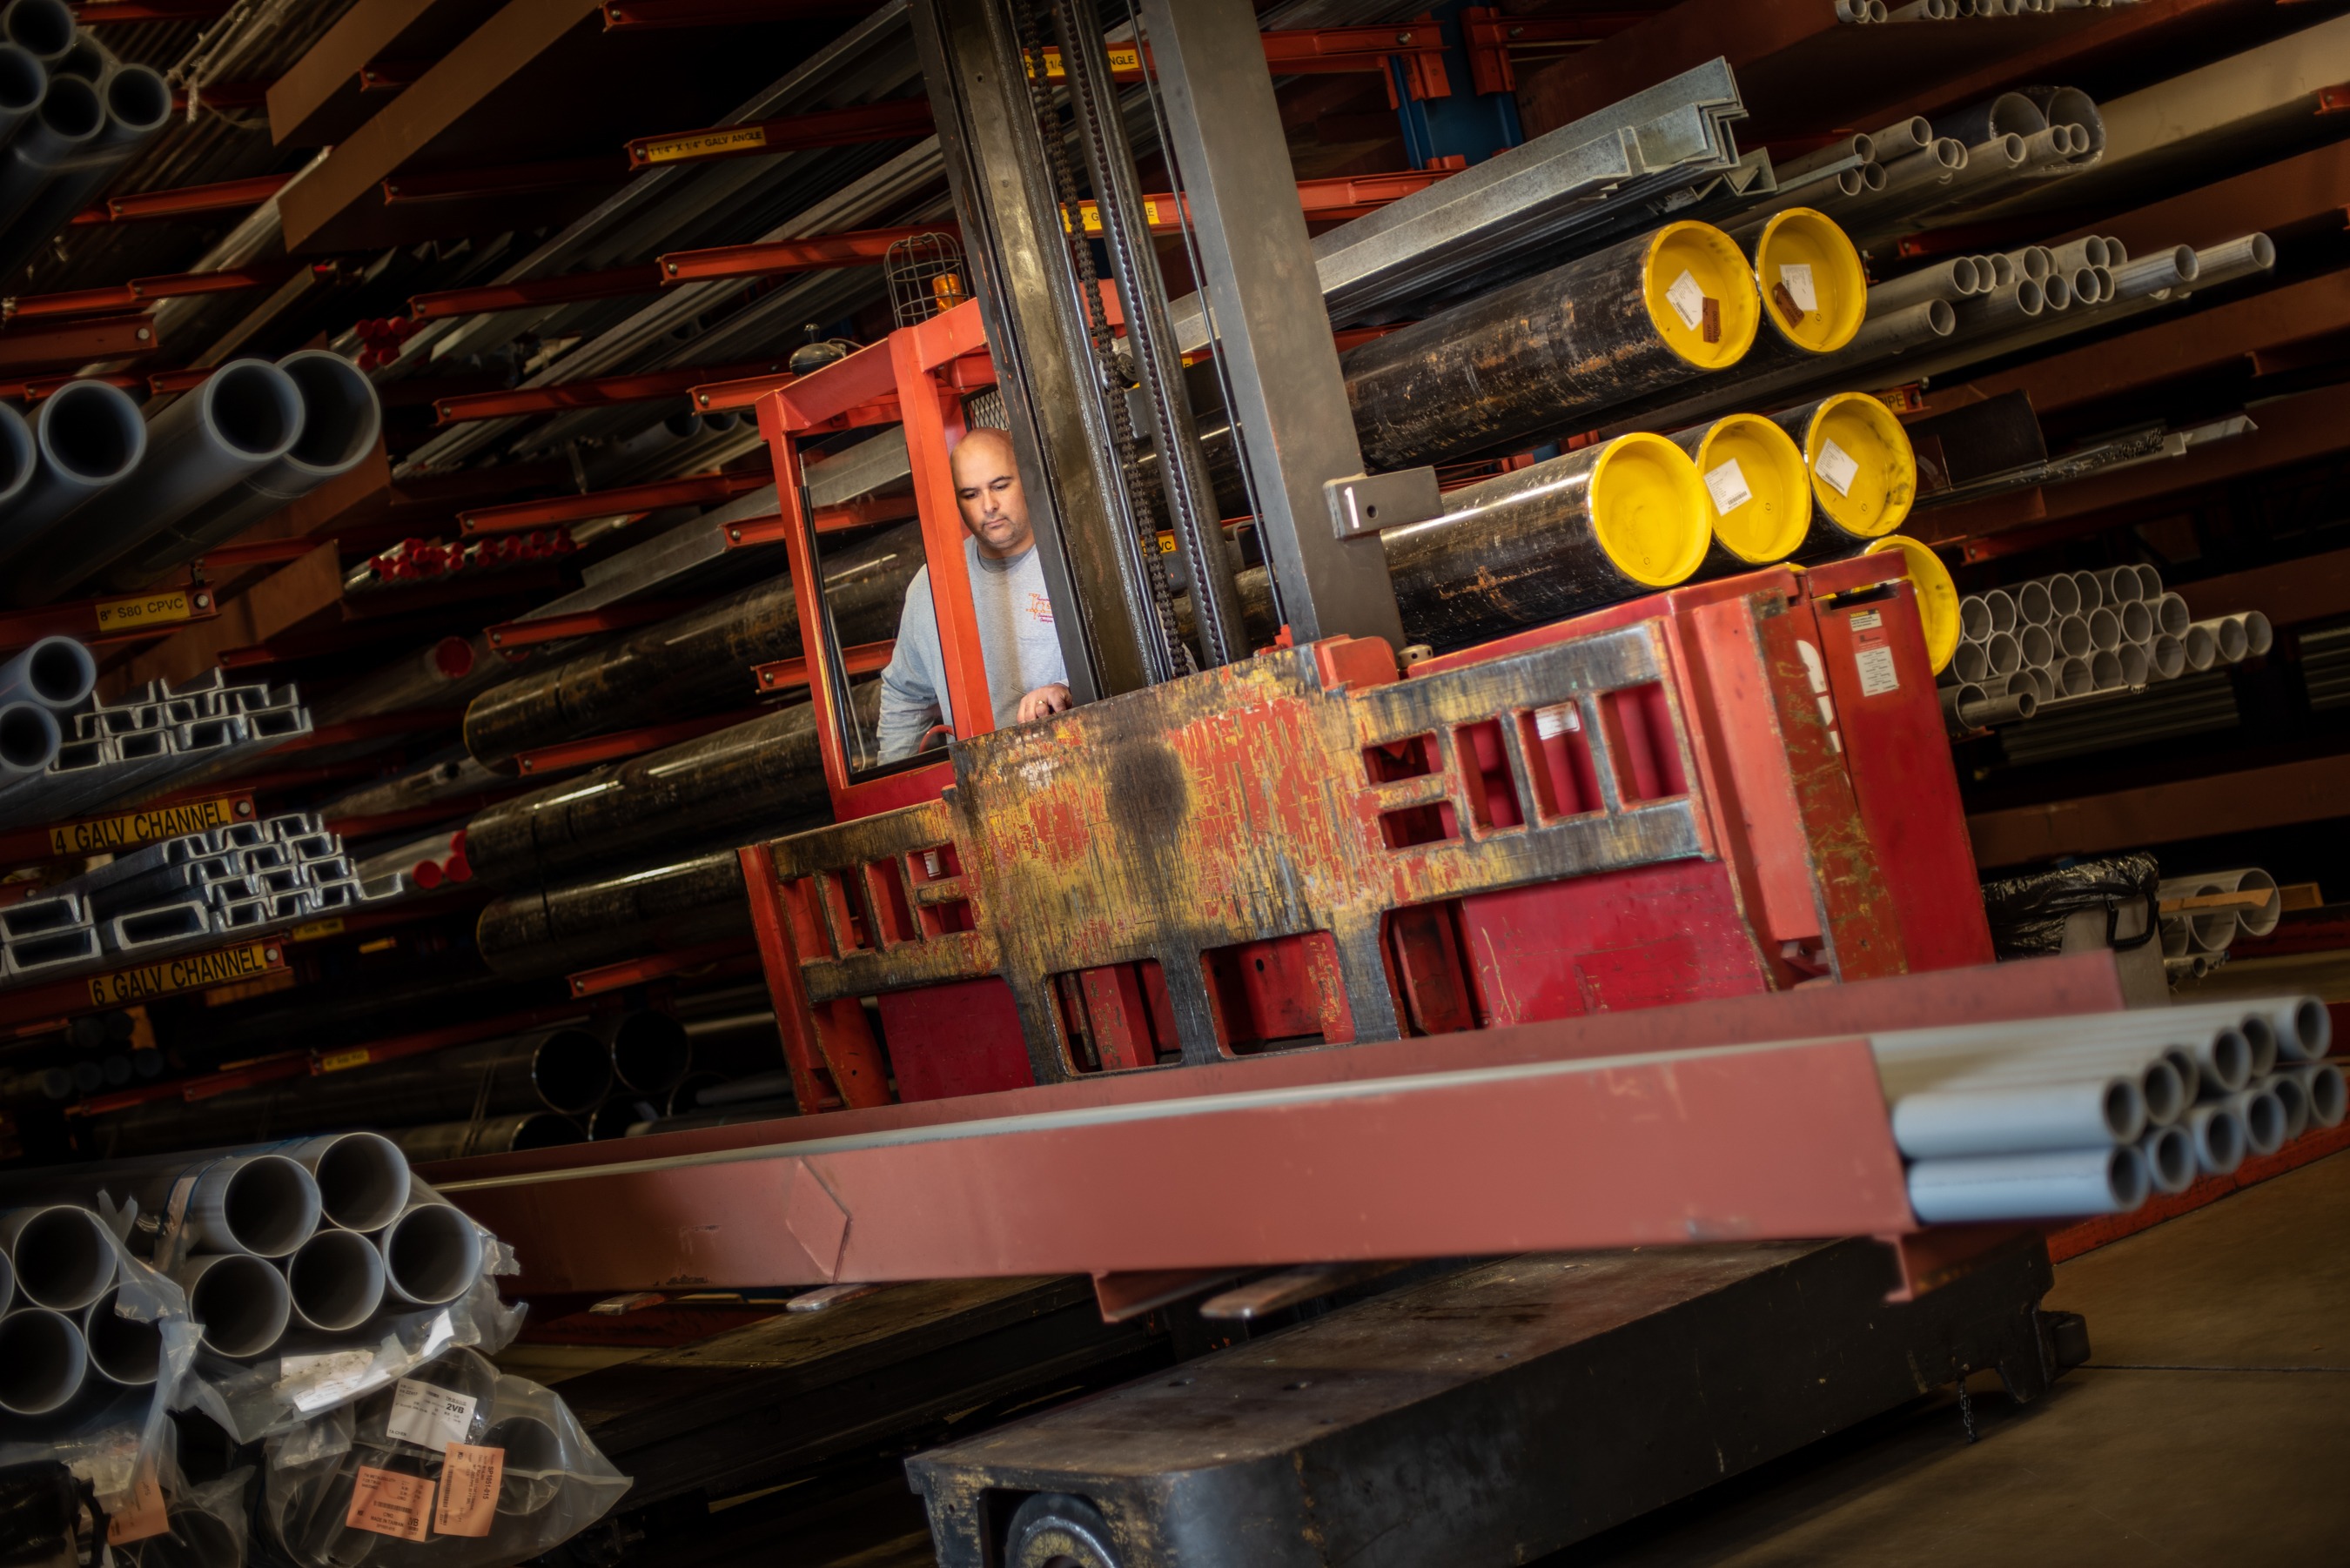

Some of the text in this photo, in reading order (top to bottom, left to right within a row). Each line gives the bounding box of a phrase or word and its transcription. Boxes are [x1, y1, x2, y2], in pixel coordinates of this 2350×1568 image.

[1108, 55, 1135, 66] NGLE
[676, 143, 682, 151] X
[705, 135, 728, 147] GALV
[732, 130, 762, 143] ANGLE
[1159, 540, 1172, 551] VC
[99, 597, 184, 621] 8" S80 CPVC
[55, 801, 228, 855] 4 GALV CHANNEL
[92, 946, 264, 1005] 6 GALV CHANNEL
[446, 1403, 465, 1415] 2VB
[482, 1465, 494, 1500] SP1051-015
